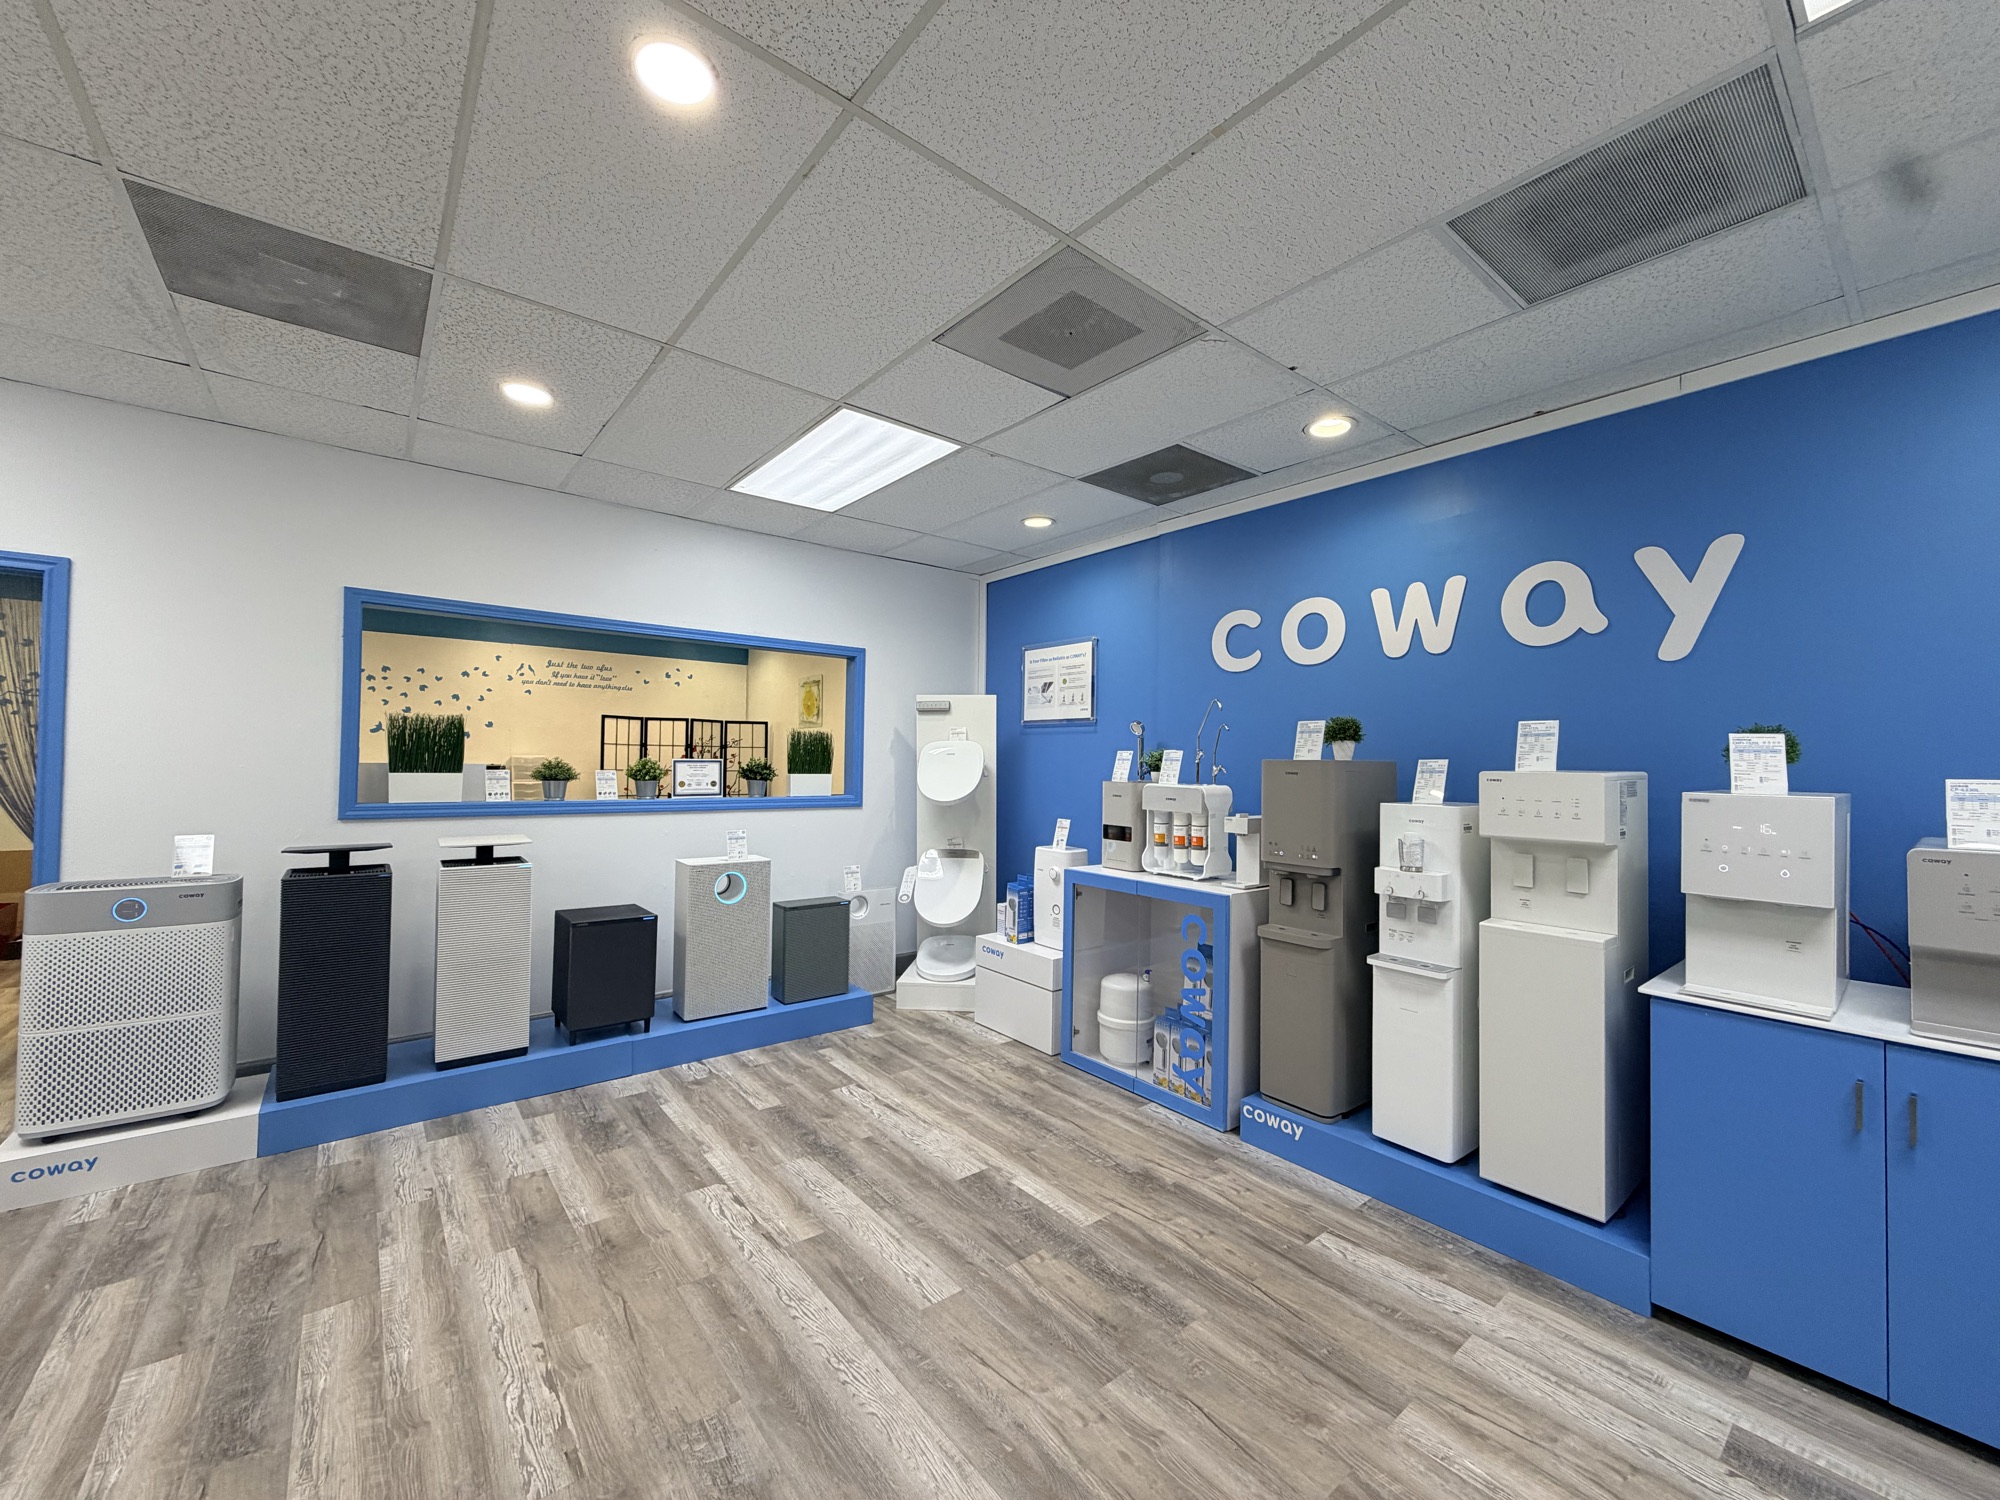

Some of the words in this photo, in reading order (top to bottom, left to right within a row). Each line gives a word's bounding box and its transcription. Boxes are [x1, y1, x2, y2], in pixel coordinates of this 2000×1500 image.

[1211, 533, 1745, 673] coway
[546, 660, 564, 668] Just
[982, 944, 1004, 959] coway
[1172, 914, 1207, 1097] coway
[1242, 1105, 1304, 1141] coway
[11, 1156, 98, 1183] coway
